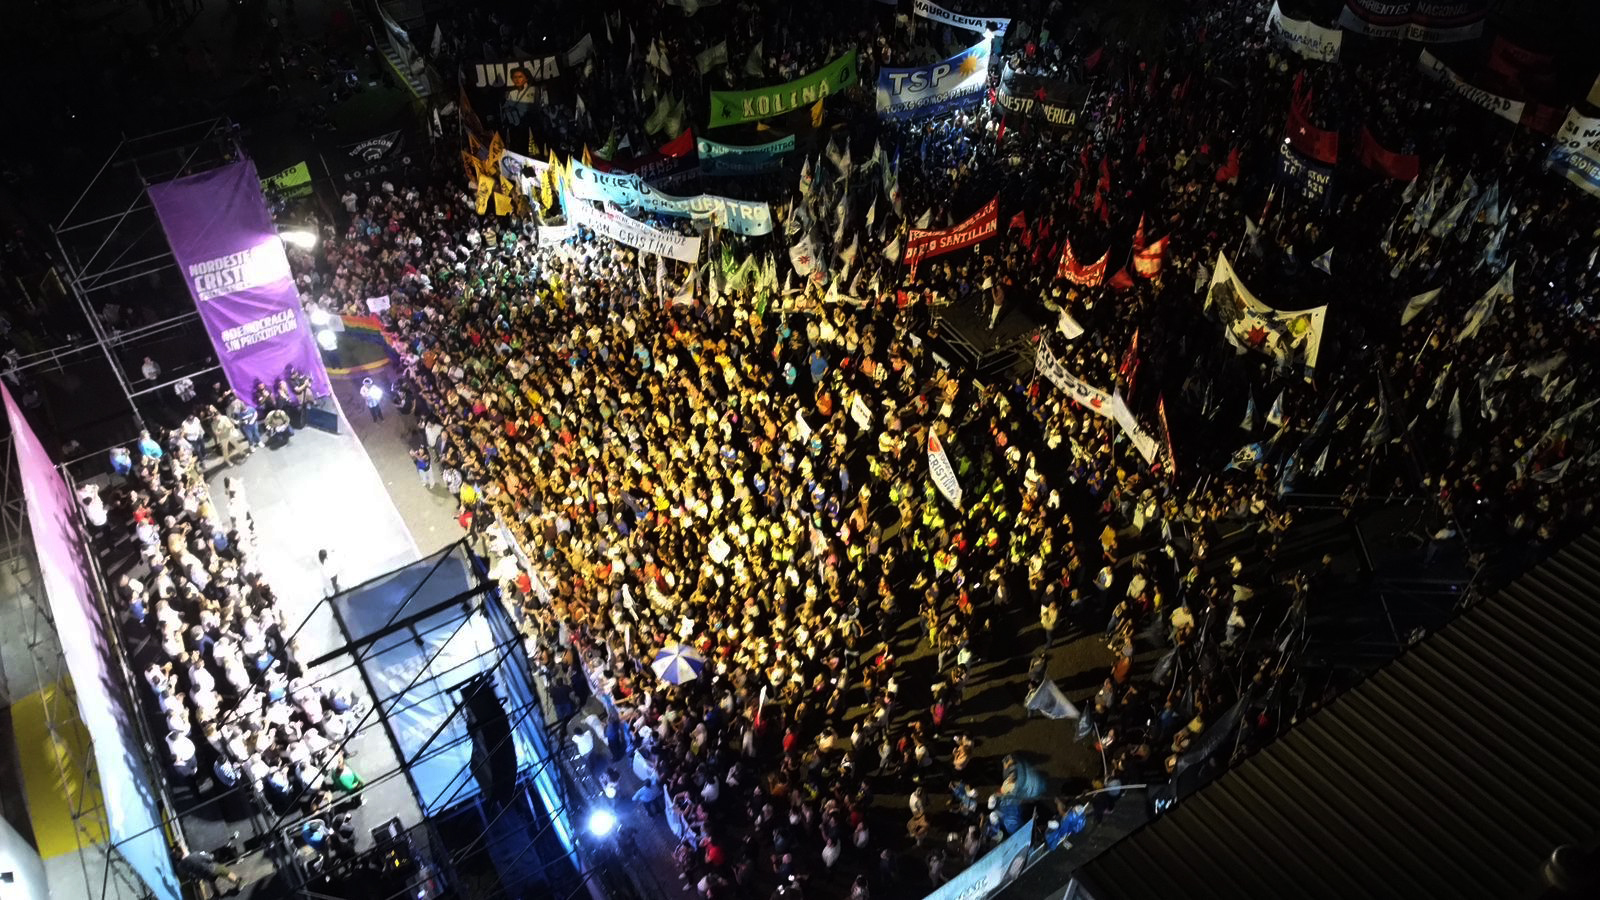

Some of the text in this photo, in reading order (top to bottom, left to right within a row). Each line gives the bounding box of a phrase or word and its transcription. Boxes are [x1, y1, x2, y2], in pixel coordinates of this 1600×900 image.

[913, 1, 950, 19] MAURO
[952, 15, 983, 27] LEIVA
[889, 63, 951, 96] TSP
[742, 79, 830, 118] KOLINA
[619, 228, 674, 257] CRISTINA
